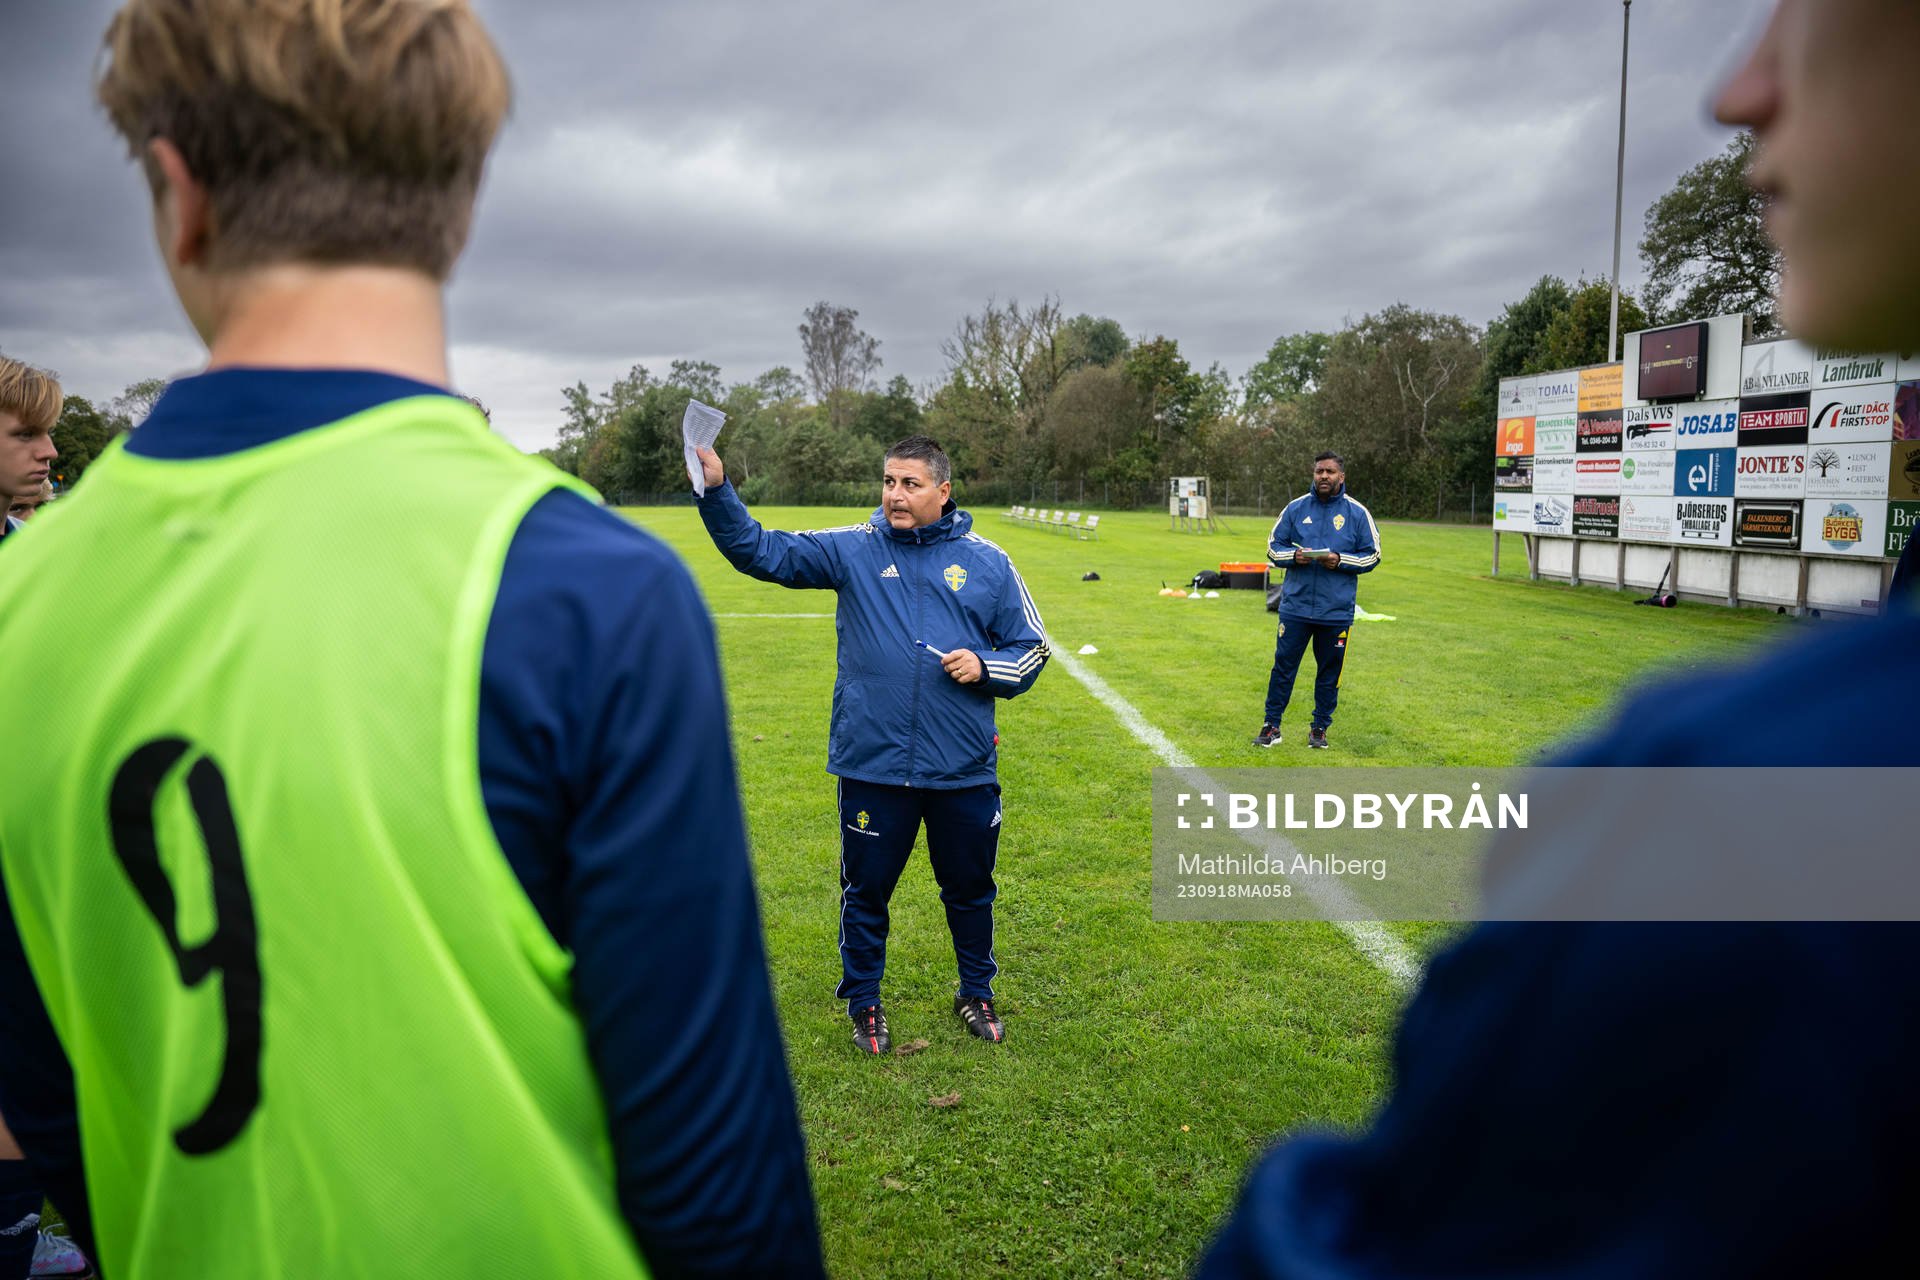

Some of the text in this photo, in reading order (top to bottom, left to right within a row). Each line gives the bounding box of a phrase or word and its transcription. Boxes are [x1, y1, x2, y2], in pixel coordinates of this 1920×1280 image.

[1822, 358, 1884, 383] Lantbruk
[1743, 376, 1754, 390] AB
[1762, 371, 1809, 388] NYLANDER
[1538, 384, 1575, 397] TOMAL
[1628, 406, 1674, 422] Dals VVS
[1843, 404, 1861, 416] ALLT
[1866, 400, 1890, 414] DÄCK
[1678, 413, 1736, 435] JOSAB
[1742, 410, 1806, 429] TEAM SPORTIA
[1852, 454, 1876, 462] LUNCH
[1852, 465, 1867, 473] FEST
[1850, 475, 1885, 484] CATERING
[1676, 501, 1727, 523] BJÖRSEREDS
[1712, 520, 1720, 531] AB
[1825, 527, 1857, 539] BYGG
[108, 734, 261, 1158] 9
